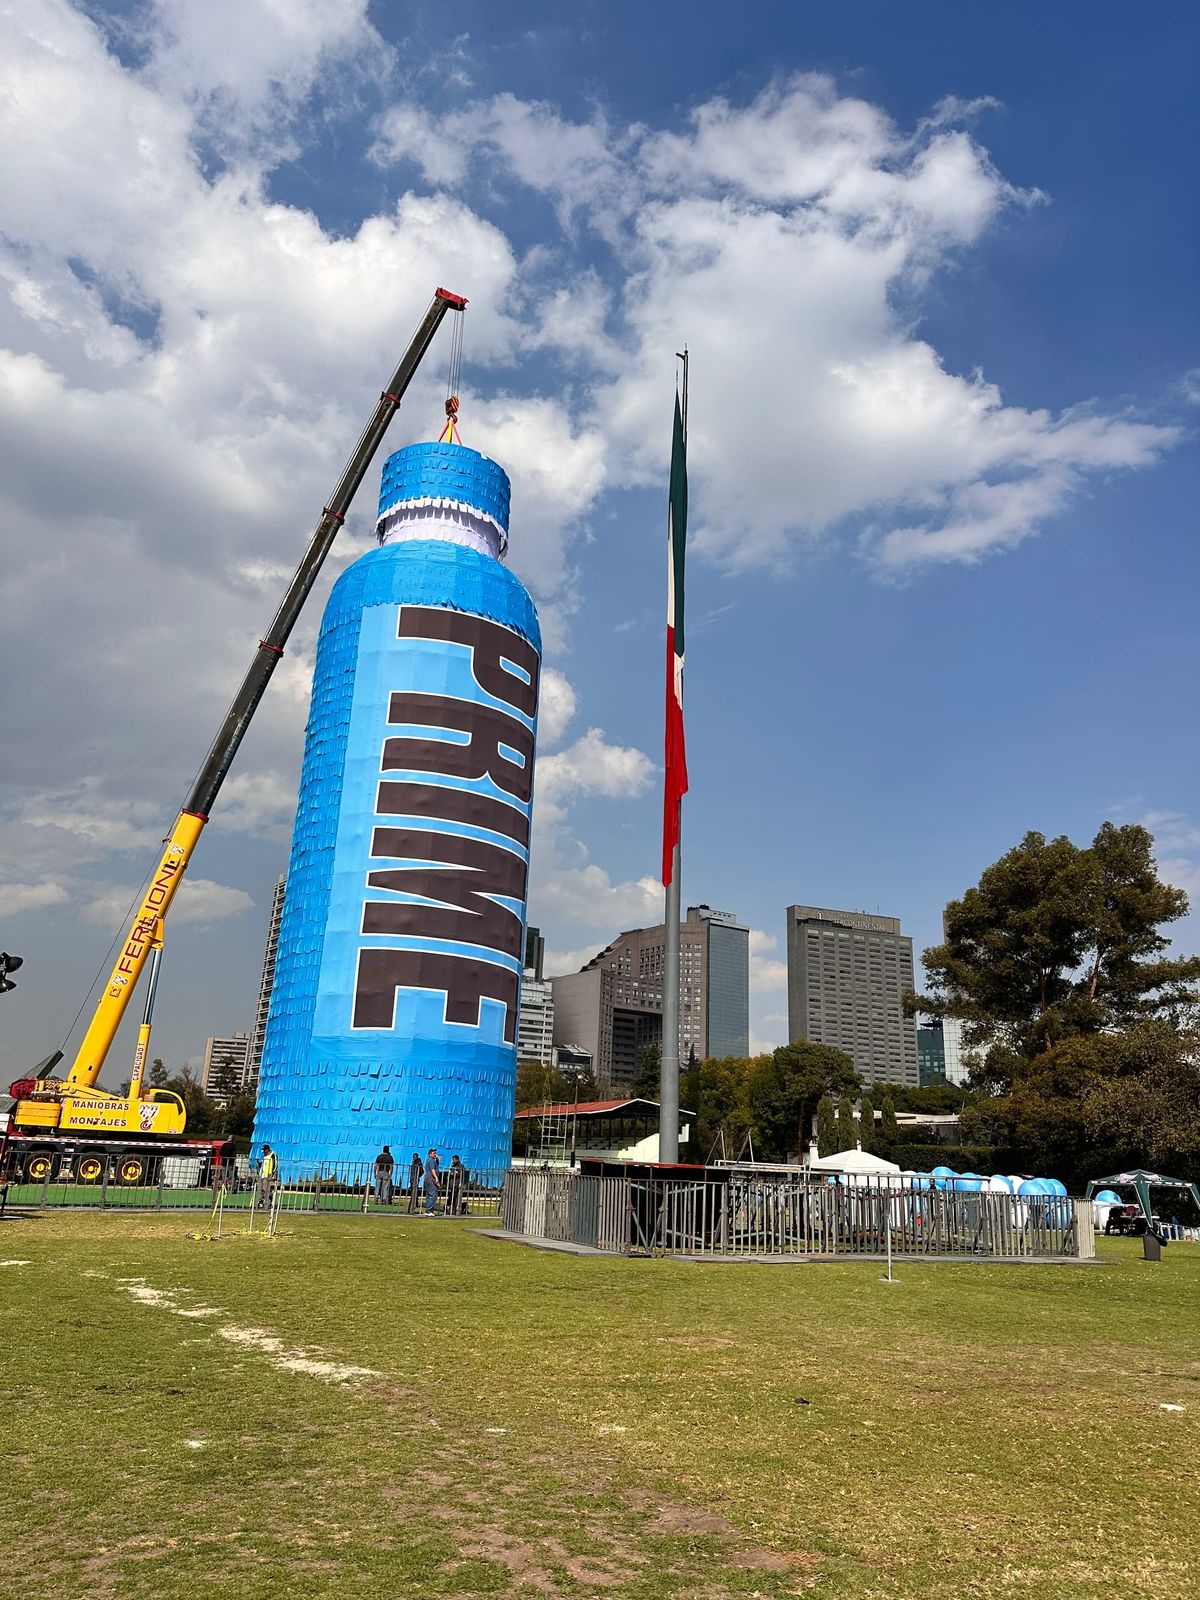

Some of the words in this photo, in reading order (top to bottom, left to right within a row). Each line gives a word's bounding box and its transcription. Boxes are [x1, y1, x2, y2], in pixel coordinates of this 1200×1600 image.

[351, 605, 540, 1046] PRIME
[73, 1101, 129, 1111] MANIOBRAS
[70, 1117, 127, 1126] MONTAJES
